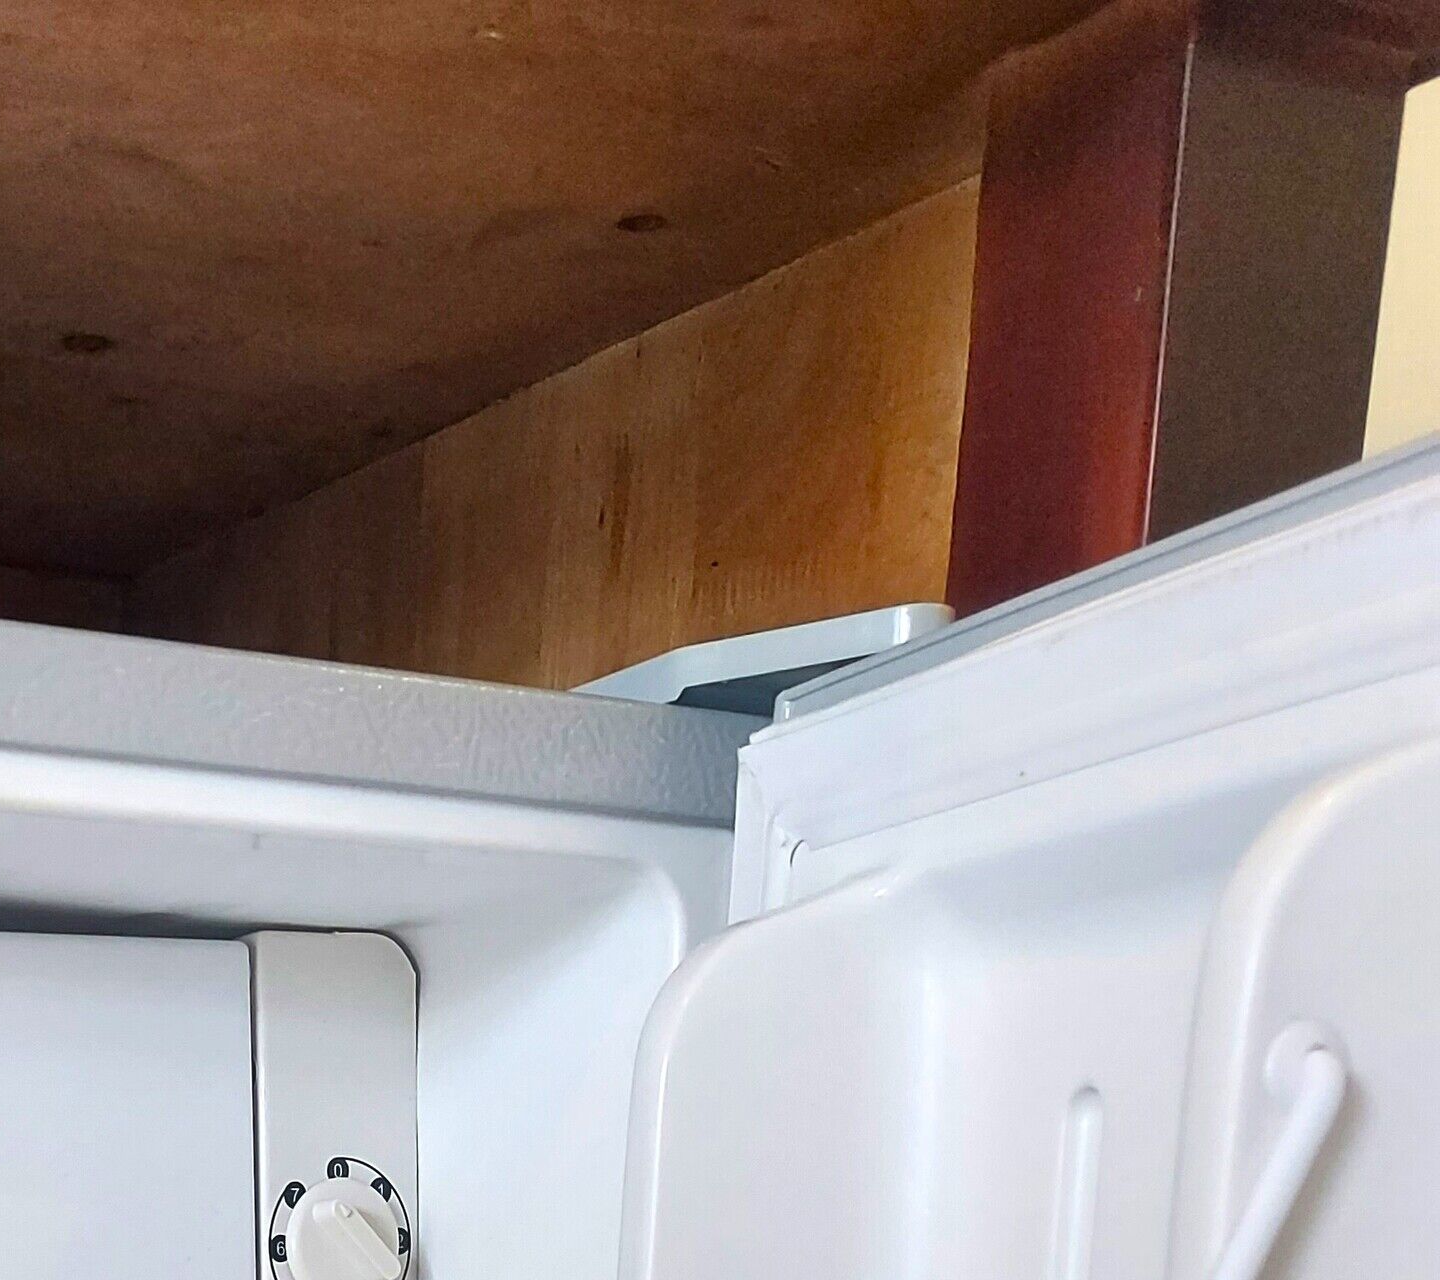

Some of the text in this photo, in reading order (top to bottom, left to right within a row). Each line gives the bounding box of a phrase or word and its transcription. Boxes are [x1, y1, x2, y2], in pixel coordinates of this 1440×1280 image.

[333, 1162, 343, 1178] 0
[291, 1187, 300, 1203] 7
[276, 1241, 286, 1257] 6
